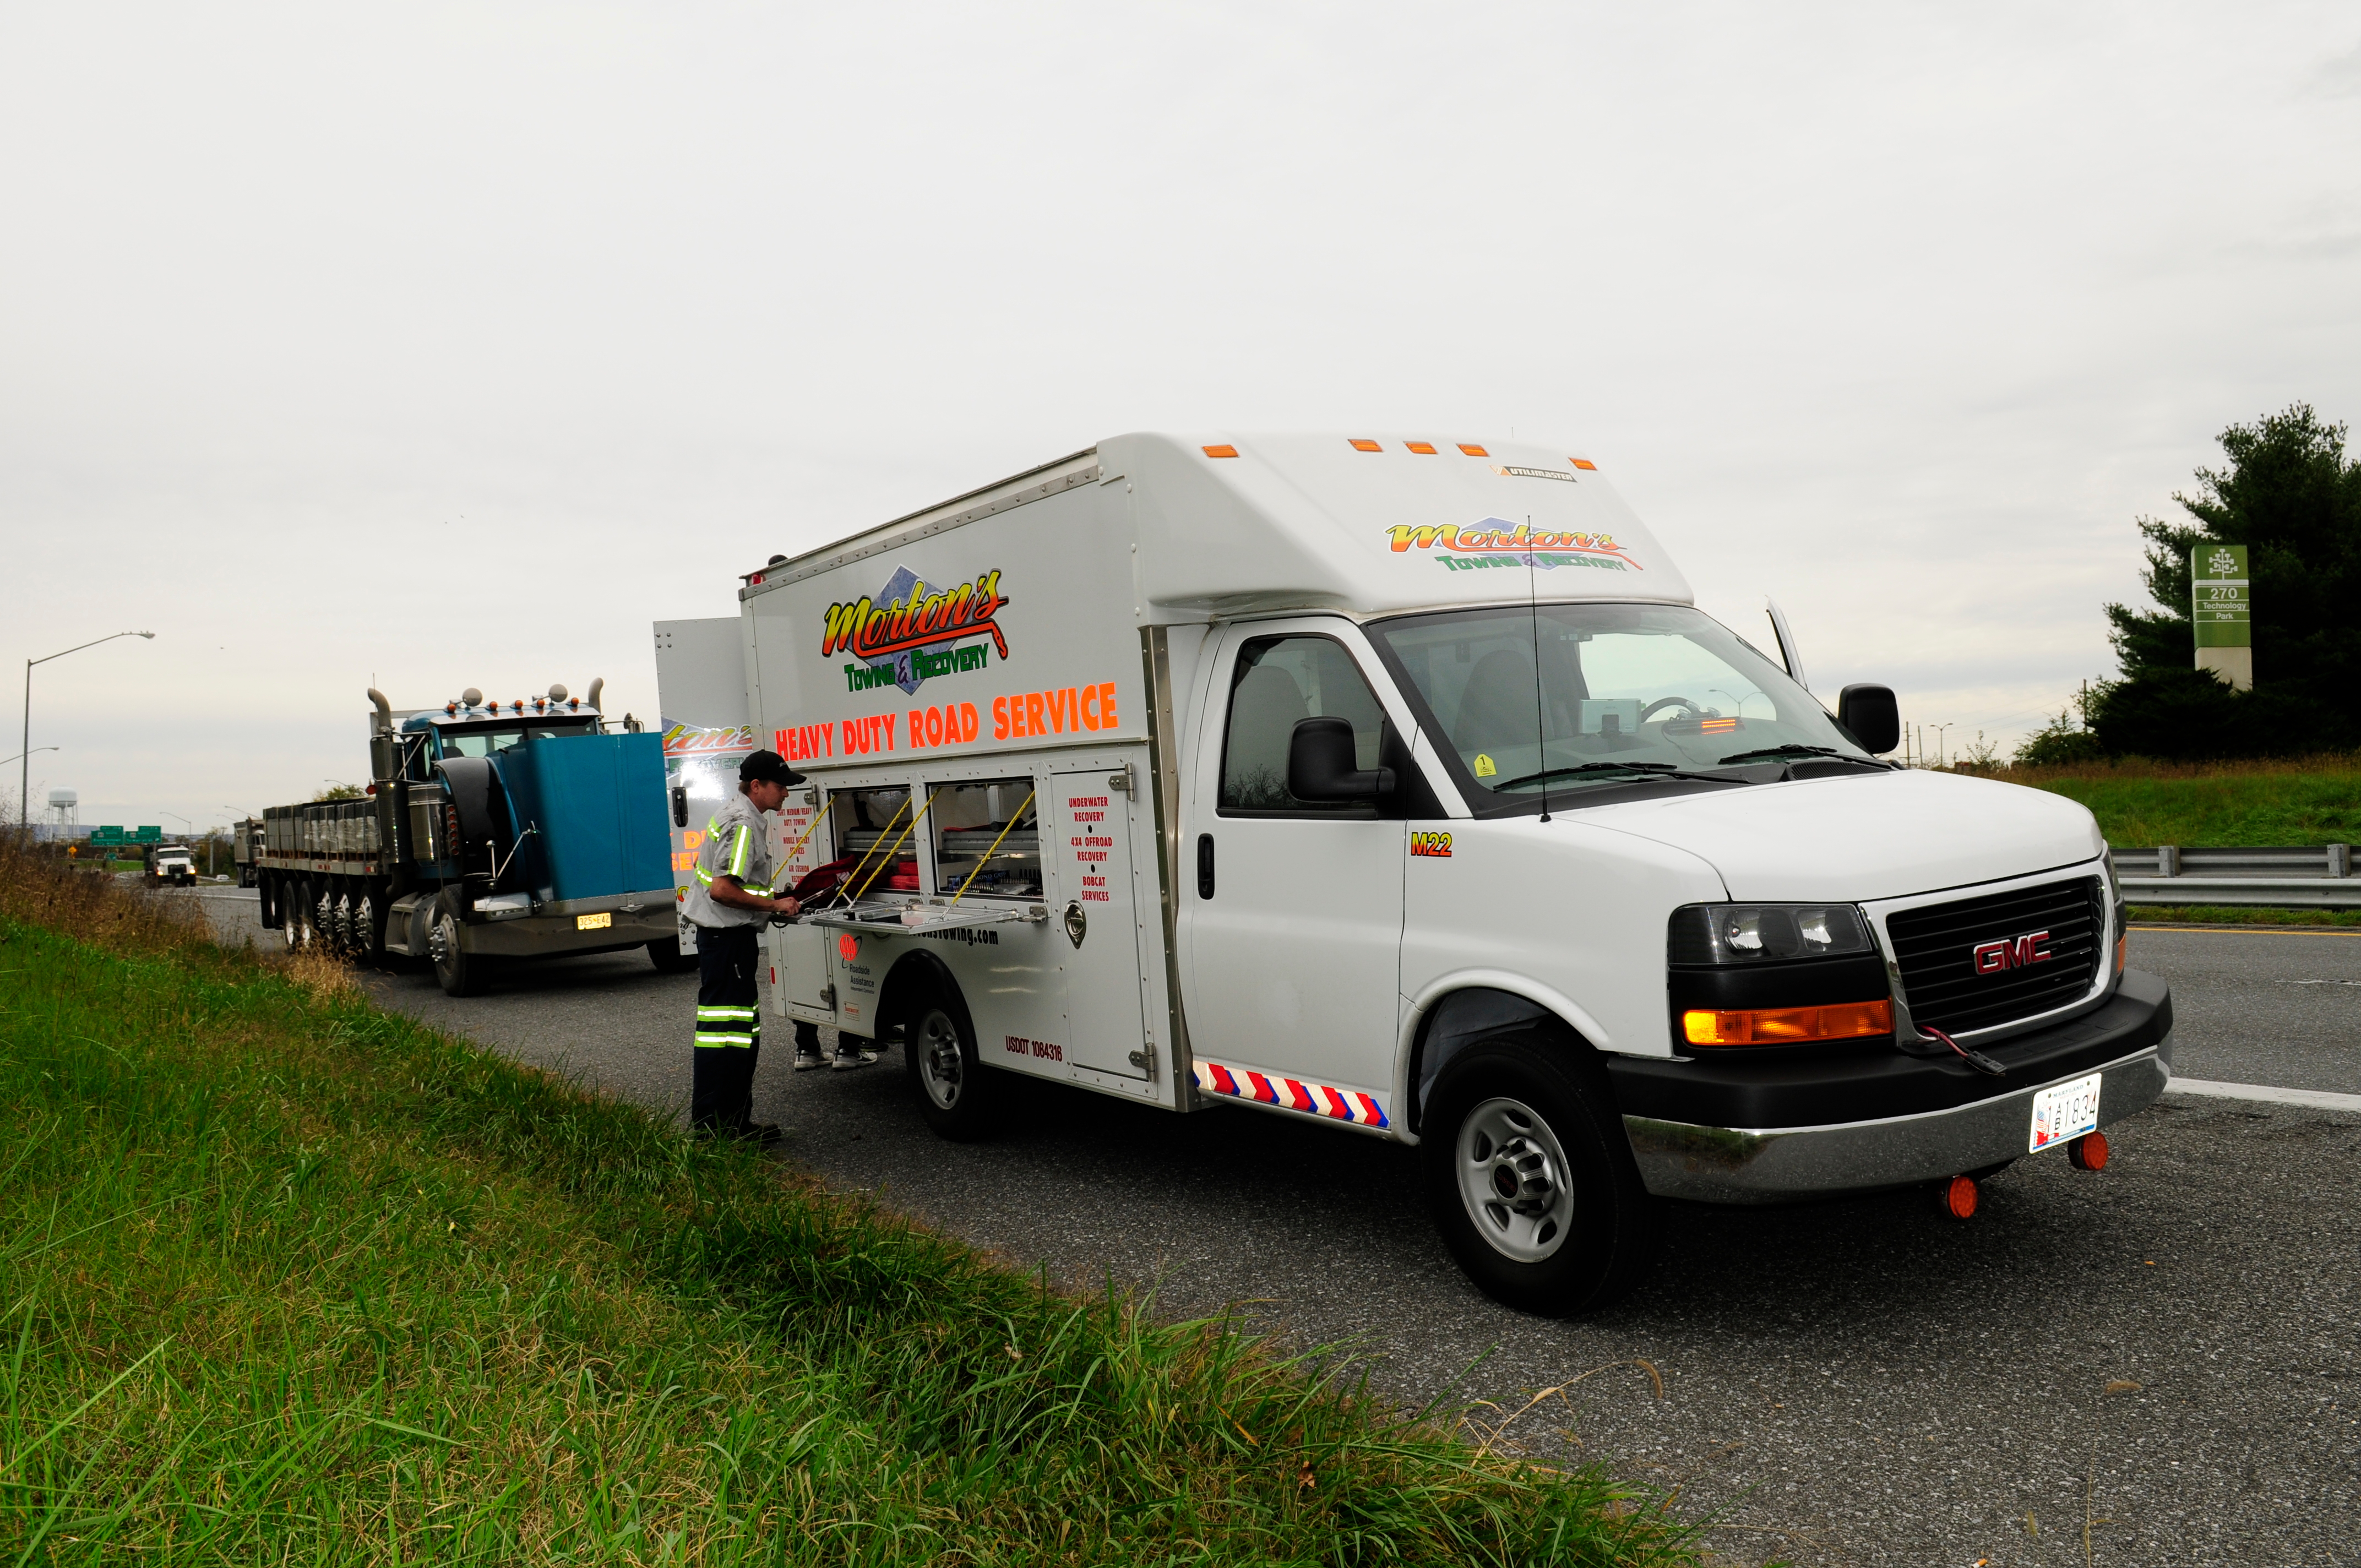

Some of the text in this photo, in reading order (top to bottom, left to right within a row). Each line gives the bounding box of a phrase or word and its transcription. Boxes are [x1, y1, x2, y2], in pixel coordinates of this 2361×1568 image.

[1384, 523, 1629, 553] Morton's
[1522, 553, 1540, 567] &
[2210, 587, 2238, 600] 270
[2202, 602, 2246, 610] Technology
[822, 568, 1010, 658] Morton's
[897, 654, 909, 684] &
[775, 682, 1118, 761] HEAVY DUTY ROAD SERVICE
[1480, 756, 1486, 765] 1
[1068, 797, 1109, 808] UNDERWATER
[1074, 812, 1105, 822] RECOVERY
[1071, 836, 1112, 847] 4X4 OFFROAD
[1411, 831, 1452, 858] M22
[1077, 851, 1107, 862] RECOVERY
[1082, 876, 1106, 887] BOBCAT
[1081, 890, 1109, 902] SERVICES
[1973, 930, 2051, 975] GMC
[849, 963, 870, 976] Roadside
[850, 975, 874, 988] Assistance
[1005, 1035, 1029, 1055] USDOT
[2053, 1085, 2083, 1098] MARYLAND
